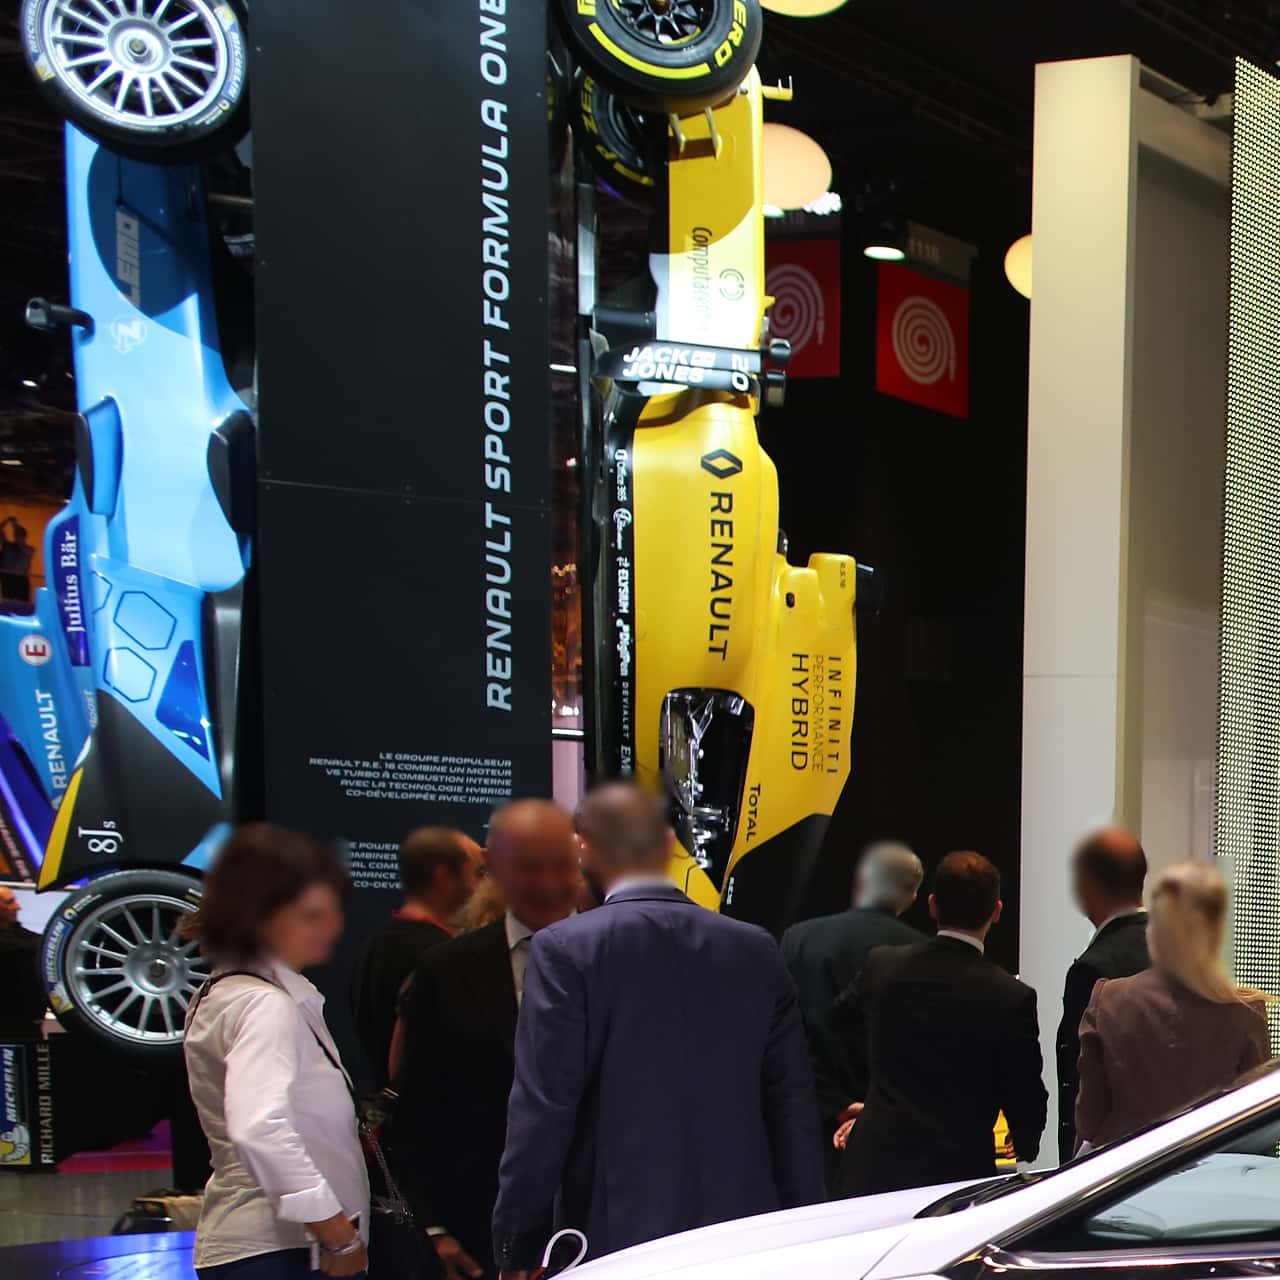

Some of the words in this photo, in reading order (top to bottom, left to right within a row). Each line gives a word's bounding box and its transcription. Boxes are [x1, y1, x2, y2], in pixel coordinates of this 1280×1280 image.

[481, 99, 510, 330] FORMULA
[622, 362, 705, 383] JONES
[623, 347, 690, 366] JACK
[731, 353, 750, 391] 20
[484, 340, 511, 493] SPORT
[61, 531, 78, 567] Bär
[708, 491, 733, 661] RENAULT
[63, 574, 86, 632] Julius
[485, 502, 512, 711] RENAULT
[25, 644, 47, 657] E
[35, 689, 68, 789] RENAULT
[791, 653, 809, 771] HYBRID
[812, 655, 824, 773] PERFORMANCE
[827, 656, 842, 774] INFINITI
[309, 757, 361, 768] RENAULT
[397, 763, 447, 773] COMBINE
[466, 767, 512, 776] MOTEUR
[326, 768, 341, 776] V6
[343, 769, 380, 778] TURBO
[391, 772, 464, 784] COMBUSTION
[465, 776, 512, 786] INTERNE
[340, 779, 370, 787] AVEC
[388, 782, 464, 793] TECHNOLOGIE
[465, 786, 512, 796] HYBRIDE
[379, 752, 393, 761] LE
[394, 753, 440, 763] GROUPE
[442, 756, 512, 767] PROPULSEUR
[438, 795, 466, 803] AVEC
[746, 783, 761, 843] TOTAL
[46, 920, 65, 982] MICHELIN
[5, 1048, 16, 1123] MICHELIN
[37, 1043, 51, 1090] MILLE
[39, 1093, 54, 1165] RICHARD
